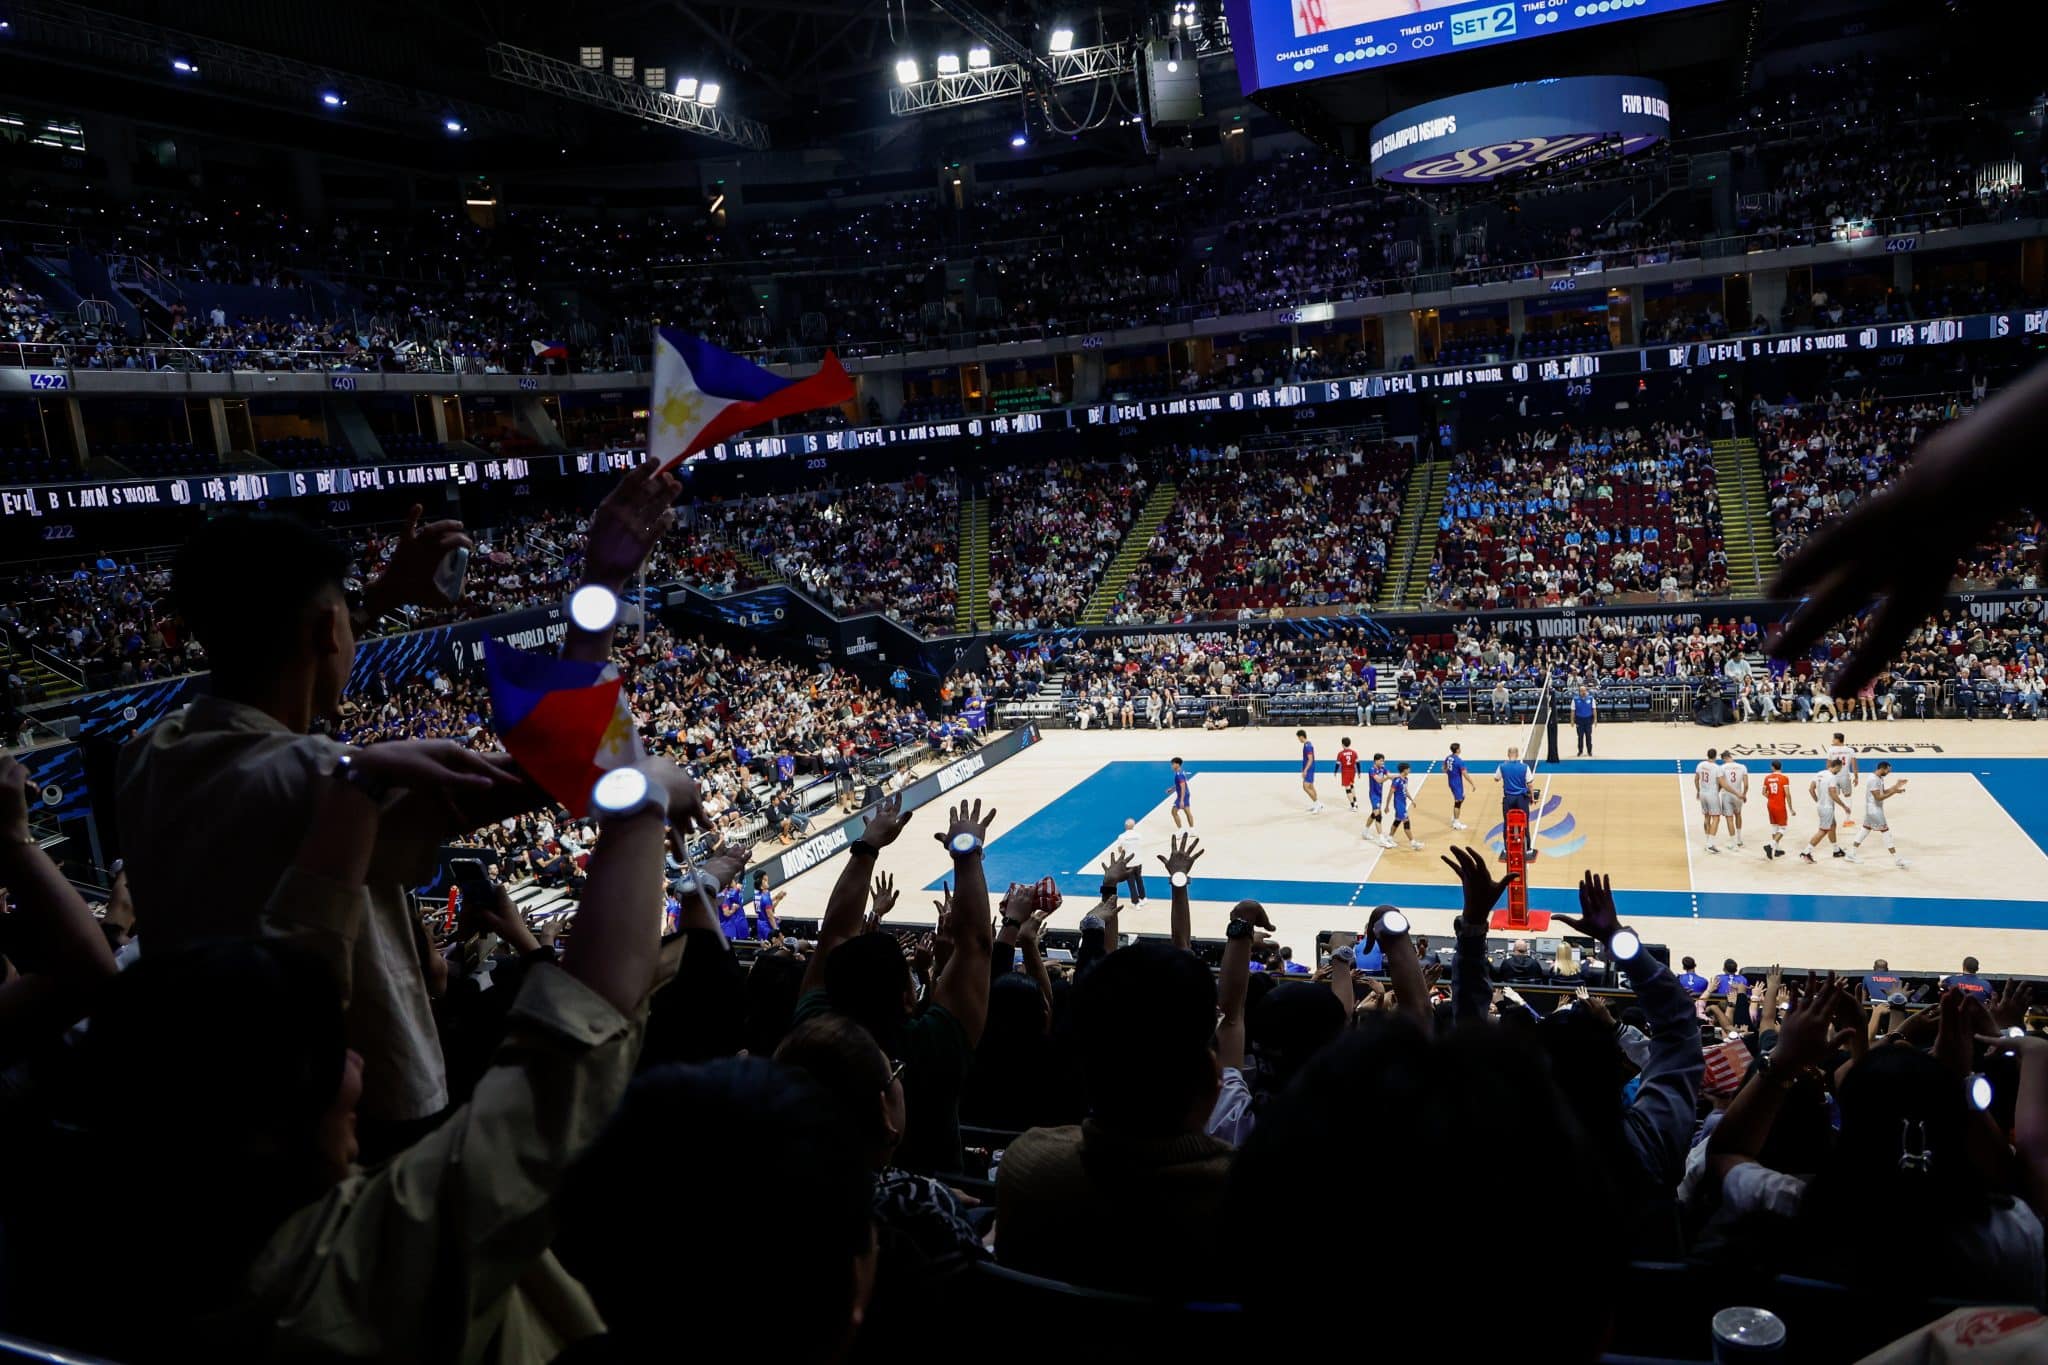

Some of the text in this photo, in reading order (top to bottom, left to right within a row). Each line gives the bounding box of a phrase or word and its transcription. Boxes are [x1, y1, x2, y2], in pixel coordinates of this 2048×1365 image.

[1522, 1, 1546, 12] TIME
[1453, 7, 1515, 36] SET 2
[1400, 21, 1445, 37] TIME OUT
[1355, 35, 1374, 46] SUB
[1276, 44, 1329, 62] CHALLENGE
[1886, 237, 1915, 251] 407
[1550, 279, 1576, 292] 406
[1280, 311, 1302, 324] 405
[1082, 336, 1103, 349] 404
[34, 373, 66, 390] 422
[334, 377, 354, 391] 401
[520, 378, 537, 391] 402
[807, 458, 827, 470] 203
[330, 500, 351, 512] 201
[44, 524, 75, 541] 222
[1960, 594, 1975, 602] 107
[548, 608, 560, 619] 101
[1536, 618, 1590, 638] WORLD
[507, 627, 545, 650] WORLD
[1726, 749, 1819, 757] PASA
[1730, 771, 1737, 783] 3
